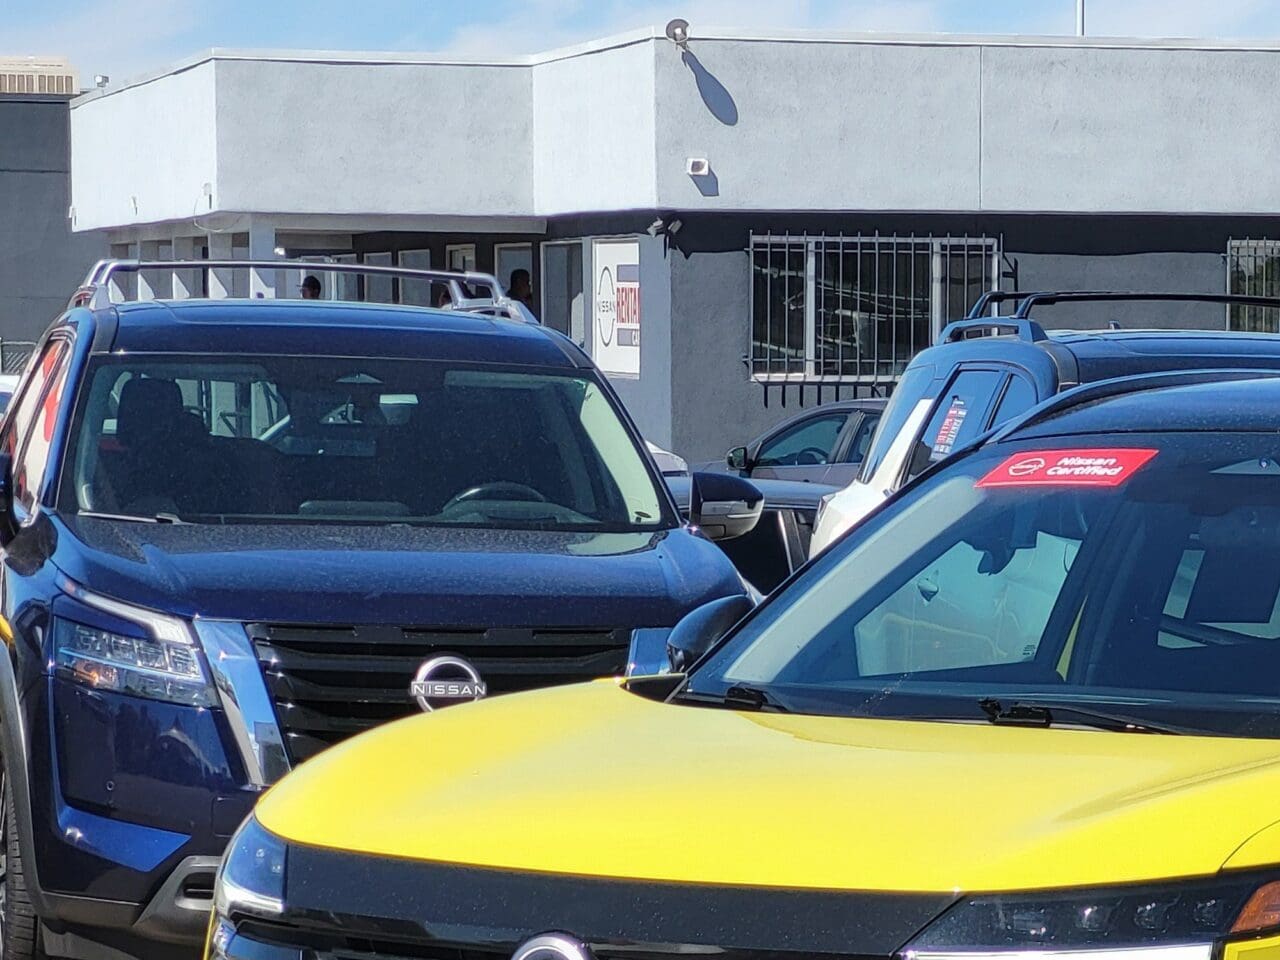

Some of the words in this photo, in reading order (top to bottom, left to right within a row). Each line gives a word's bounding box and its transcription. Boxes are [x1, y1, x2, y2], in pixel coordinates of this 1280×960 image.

[1056, 456, 1116, 467] Nissan
[1046, 465, 1123, 477] Certified
[413, 684, 485, 695] NISSAN
